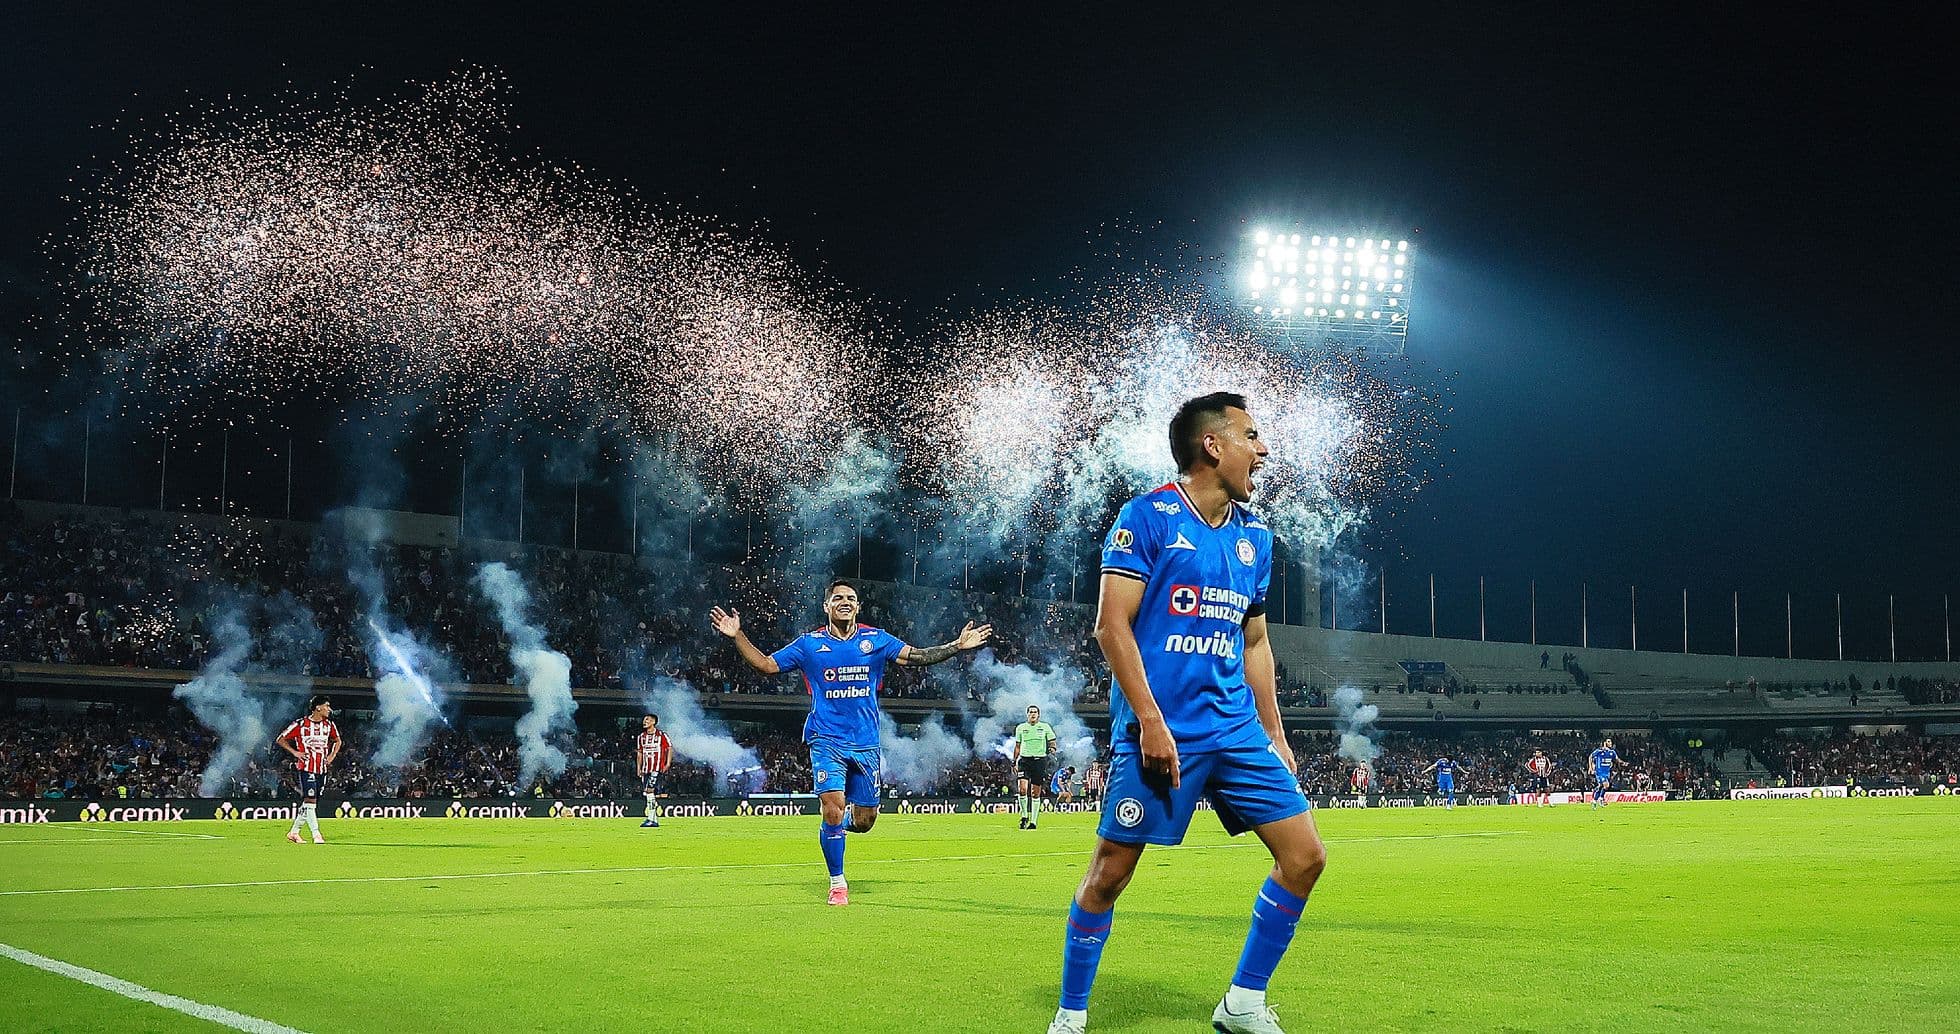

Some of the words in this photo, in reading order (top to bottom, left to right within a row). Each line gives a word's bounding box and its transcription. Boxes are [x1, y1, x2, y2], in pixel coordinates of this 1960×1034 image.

[1199, 604, 1230, 620] CRUZ
[838, 666, 870, 674] CEMENTO
[838, 674, 855, 682] CRUZ
[826, 686, 870, 699] novibet
[1735, 790, 1809, 800] Gasolineras
[1868, 786, 1915, 798] cemix
[914, 801, 955, 814] cemix
[1388, 796, 1415, 808] cemix
[1475, 795, 1499, 806] cemix
[108, 803, 184, 822] cemix
[241, 803, 298, 820] cemi
[359, 802, 426, 818] cemix
[469, 802, 528, 818] cemix
[572, 802, 625, 818] cemix
[664, 801, 716, 817] cemix
[755, 801, 803, 816] cemix
